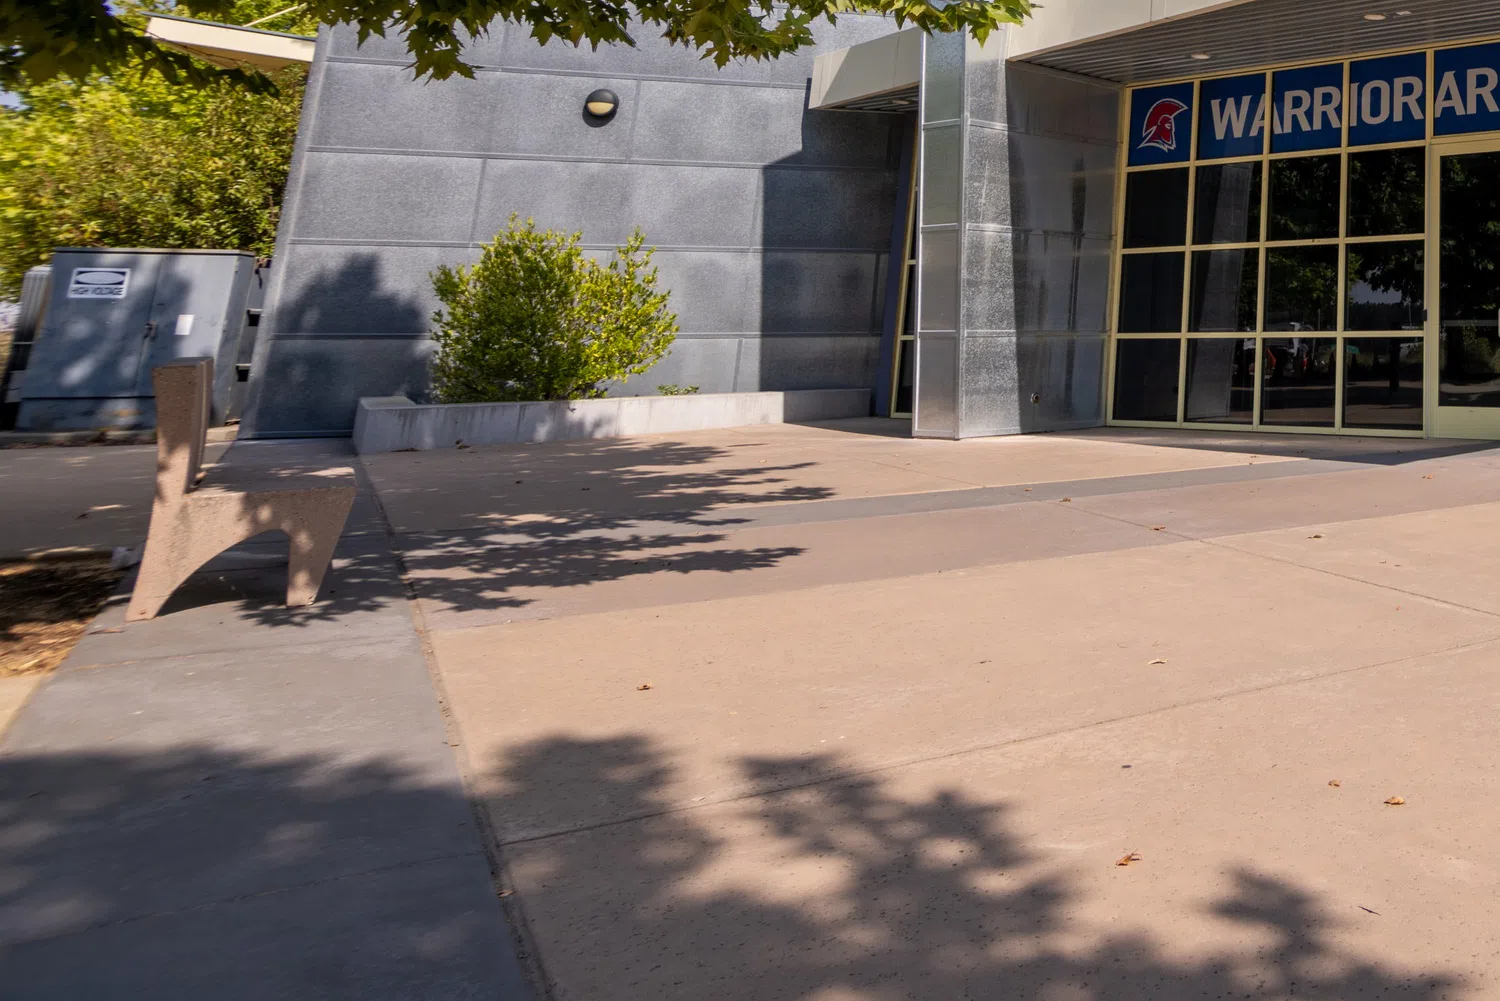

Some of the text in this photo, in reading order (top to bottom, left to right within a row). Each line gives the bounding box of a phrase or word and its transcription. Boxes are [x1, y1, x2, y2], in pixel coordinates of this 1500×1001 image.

[1210, 76, 1424, 140] WARRIOR
[70, 287, 124, 296] HIGH VOLTAGE
